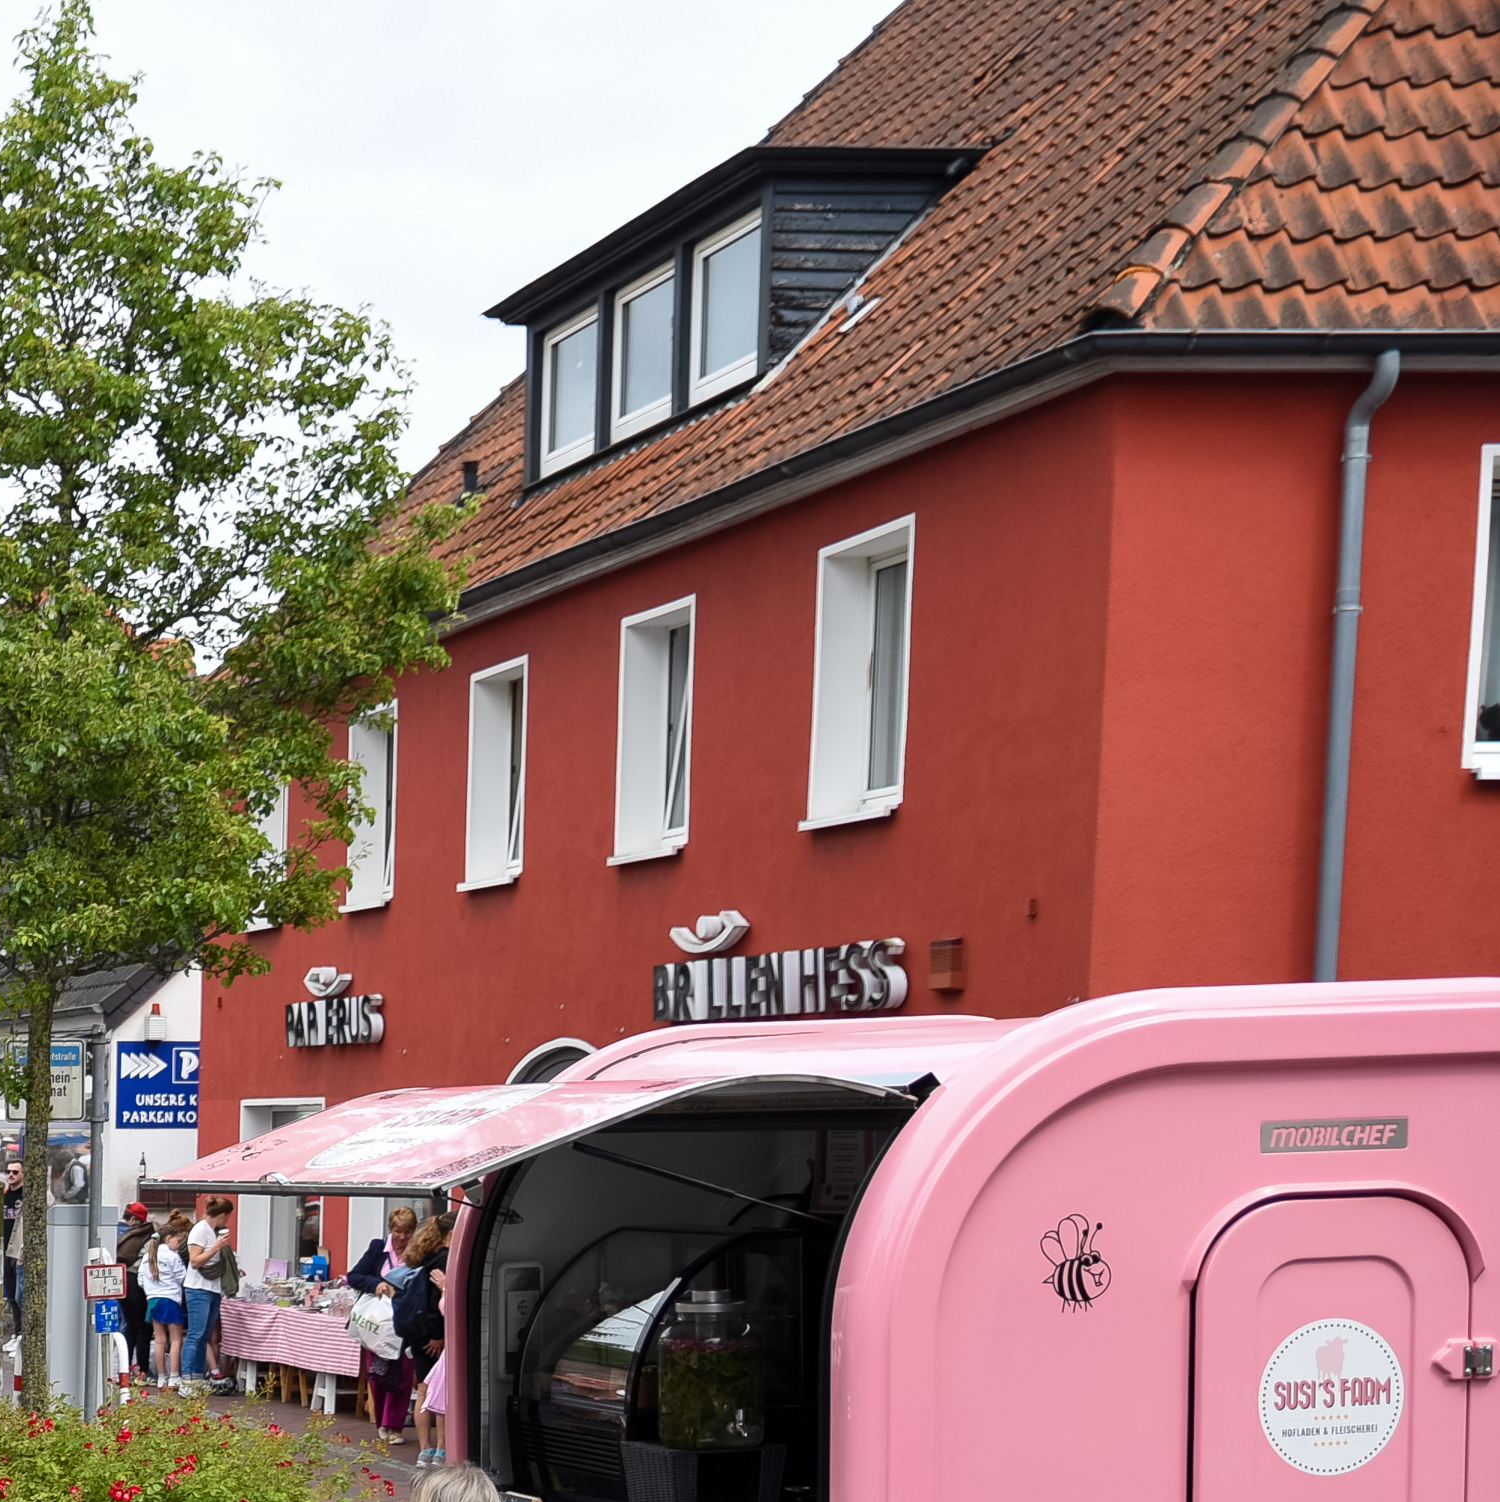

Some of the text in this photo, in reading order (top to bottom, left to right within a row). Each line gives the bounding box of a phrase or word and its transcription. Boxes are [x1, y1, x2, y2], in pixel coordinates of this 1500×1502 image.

[135, 1093, 186, 1106] UNSERE
[122, 1111, 174, 1123] PARKEN
[1269, 1124, 1398, 1148] MOBILCHEF
[1274, 1376, 1391, 1411] SUSI'S FARM
[1281, 1424, 1378, 1438] HOFLADEN & FLEISCHEREI
